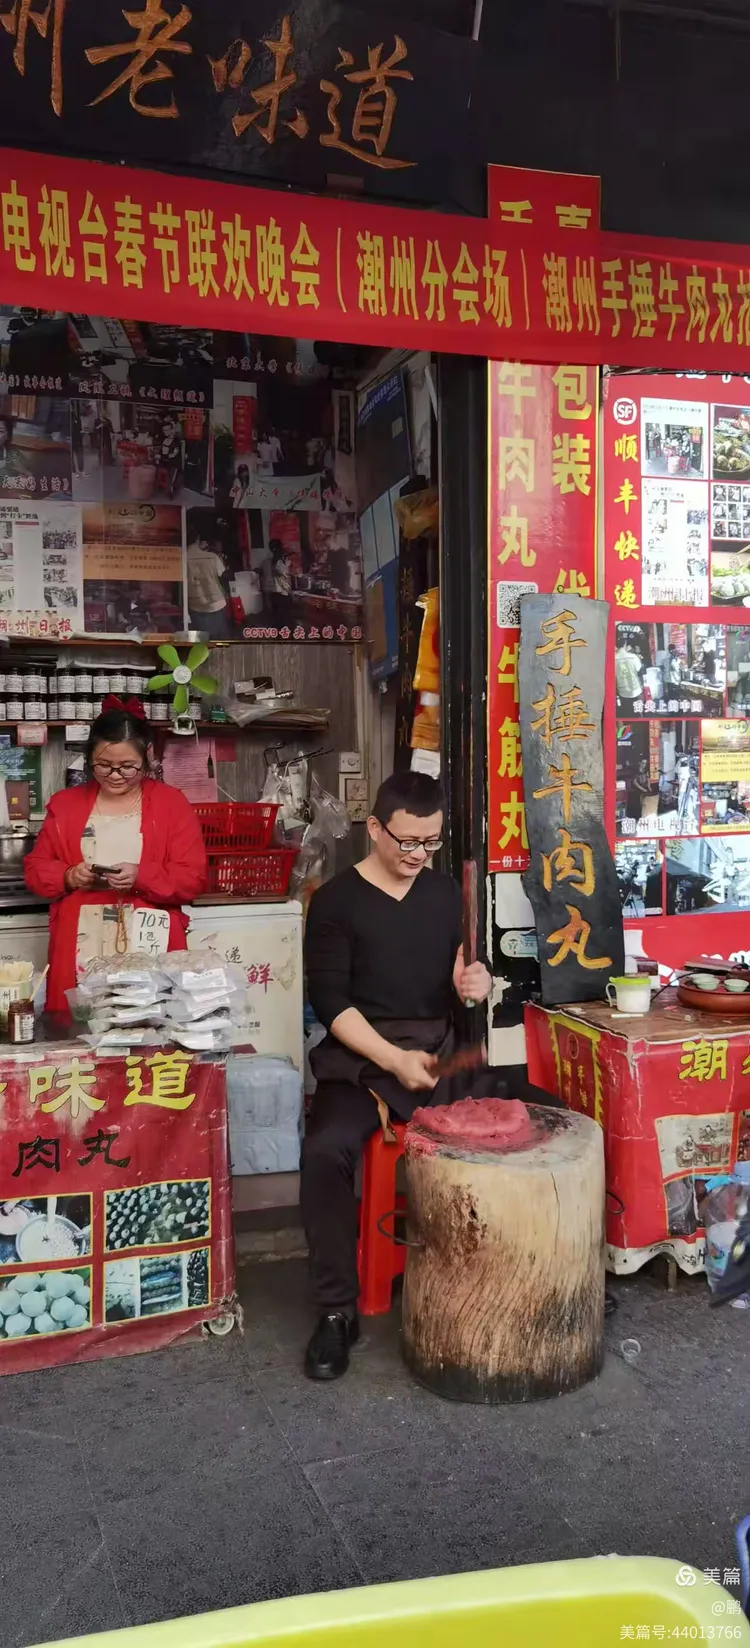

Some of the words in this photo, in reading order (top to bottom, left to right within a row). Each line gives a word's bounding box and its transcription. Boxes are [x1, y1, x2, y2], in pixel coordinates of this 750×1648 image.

[613, 432, 640, 609] 顺丰快递
[531, 608, 612, 970] 手捶牛肉丸
[137, 911, 169, 929] 70元
[0, 1050, 197, 1118] 味道
[679, 1037, 750, 1081] 潮
[12, 1129, 132, 1177] 肉丸
